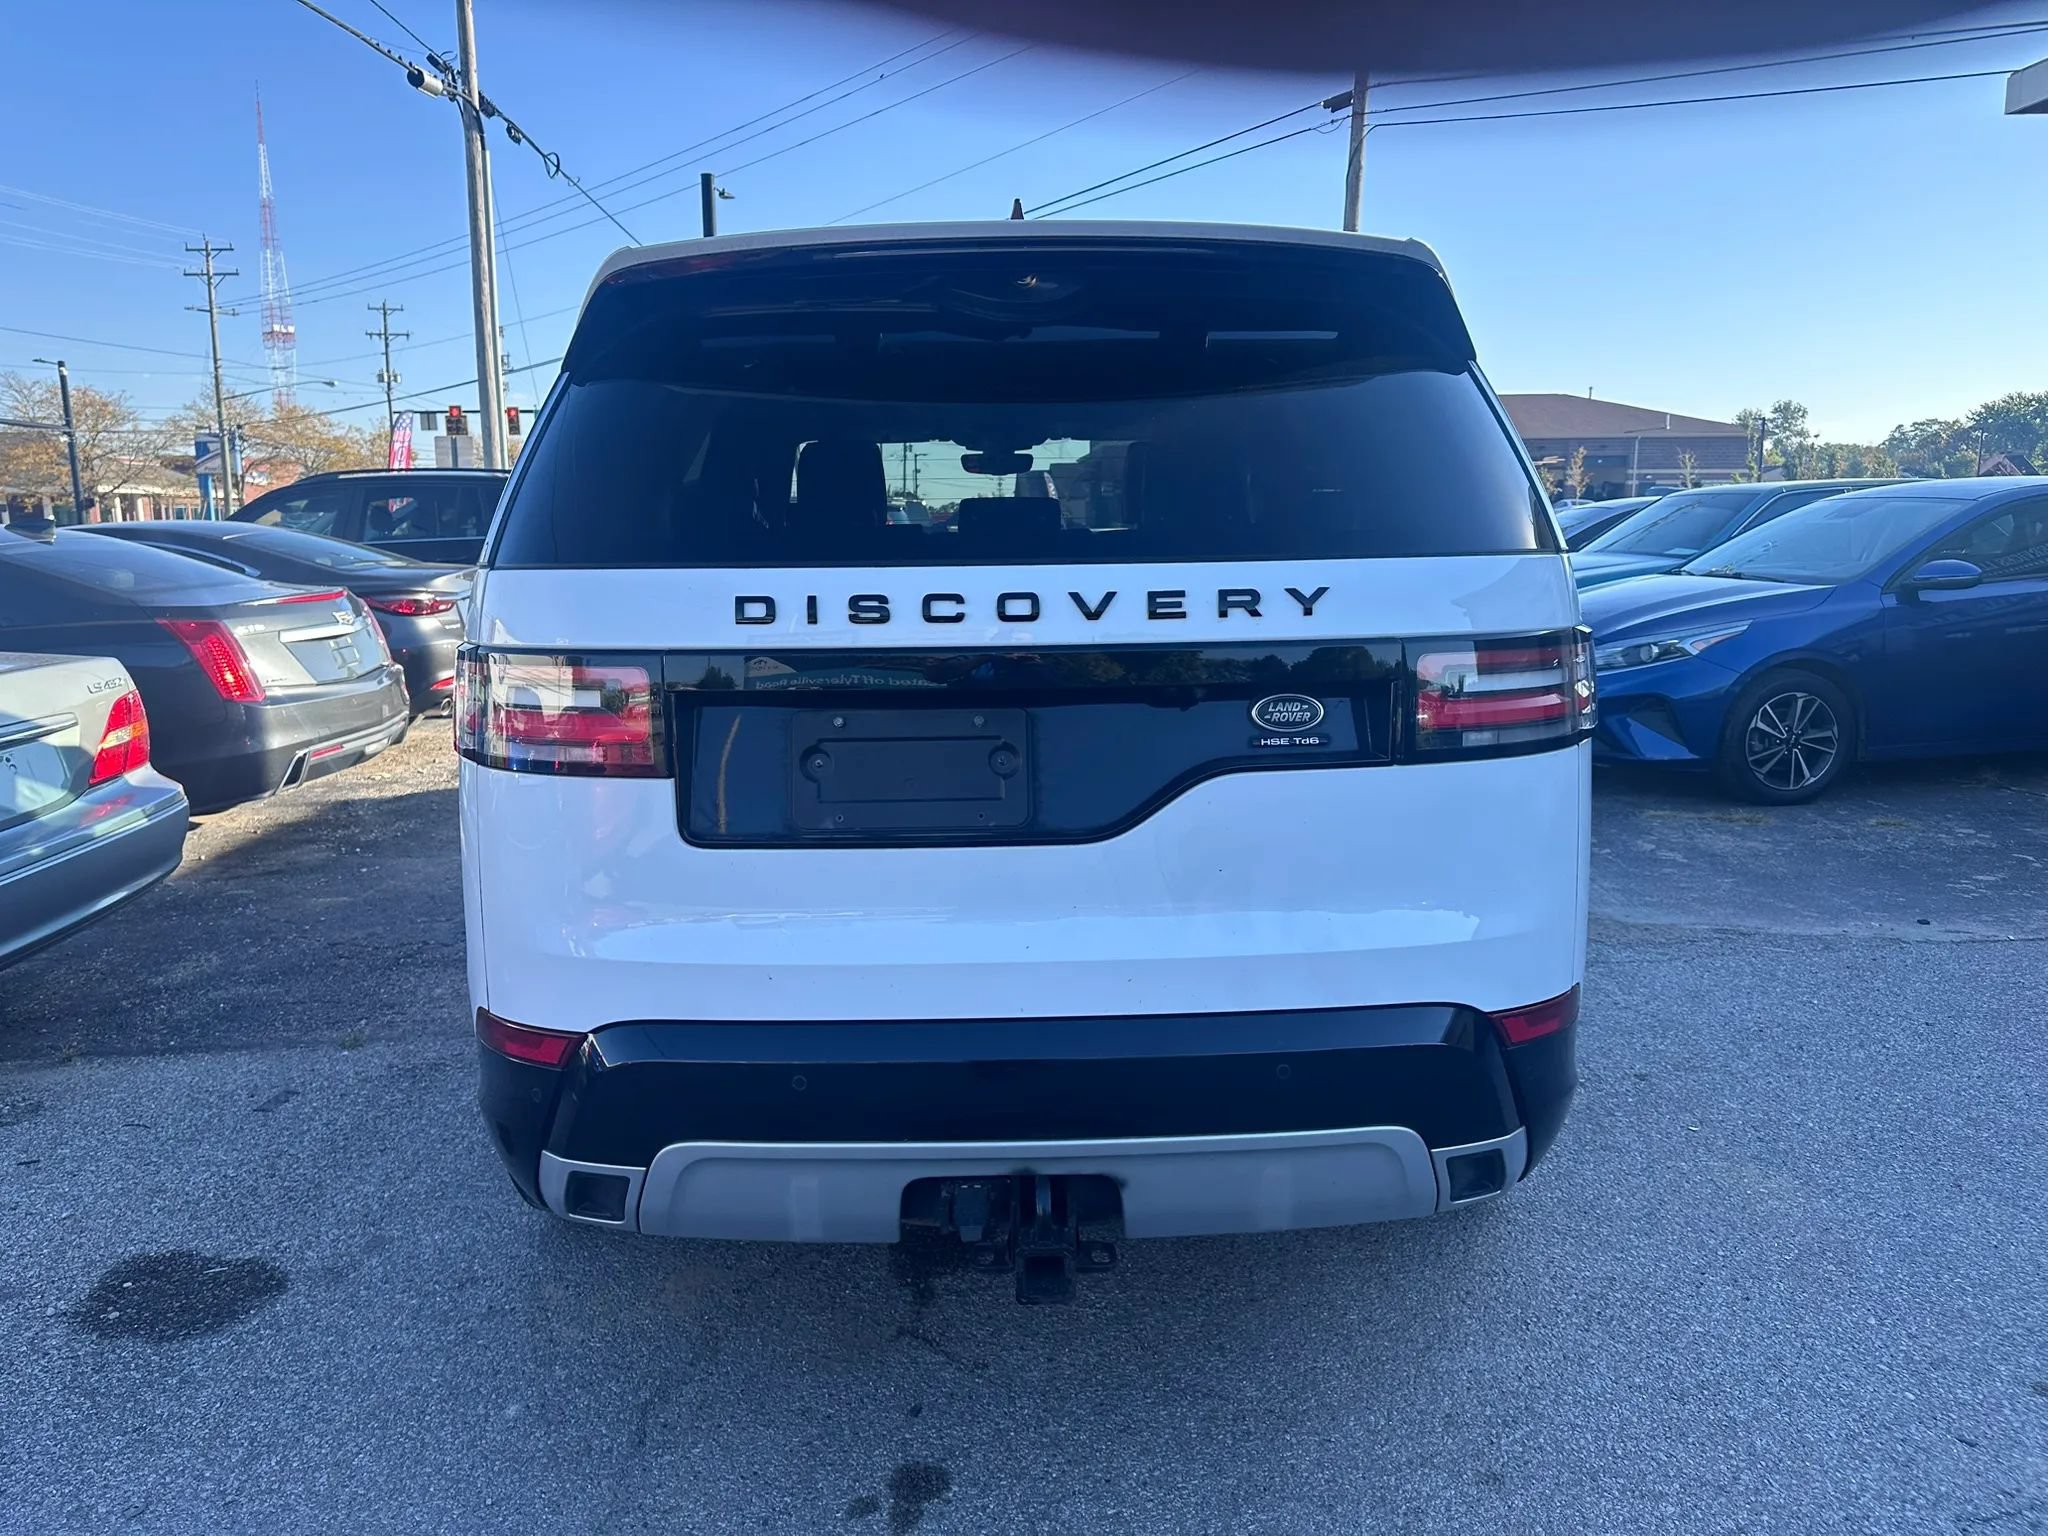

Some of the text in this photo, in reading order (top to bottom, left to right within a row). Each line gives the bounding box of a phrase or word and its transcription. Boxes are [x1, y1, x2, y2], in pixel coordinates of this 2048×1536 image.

[735, 586, 1330, 625] DISCOVERY
[1268, 702, 1301, 712] LAND
[1271, 712, 1311, 722] ROVER
[1261, 736, 1320, 746] HSE Td6
